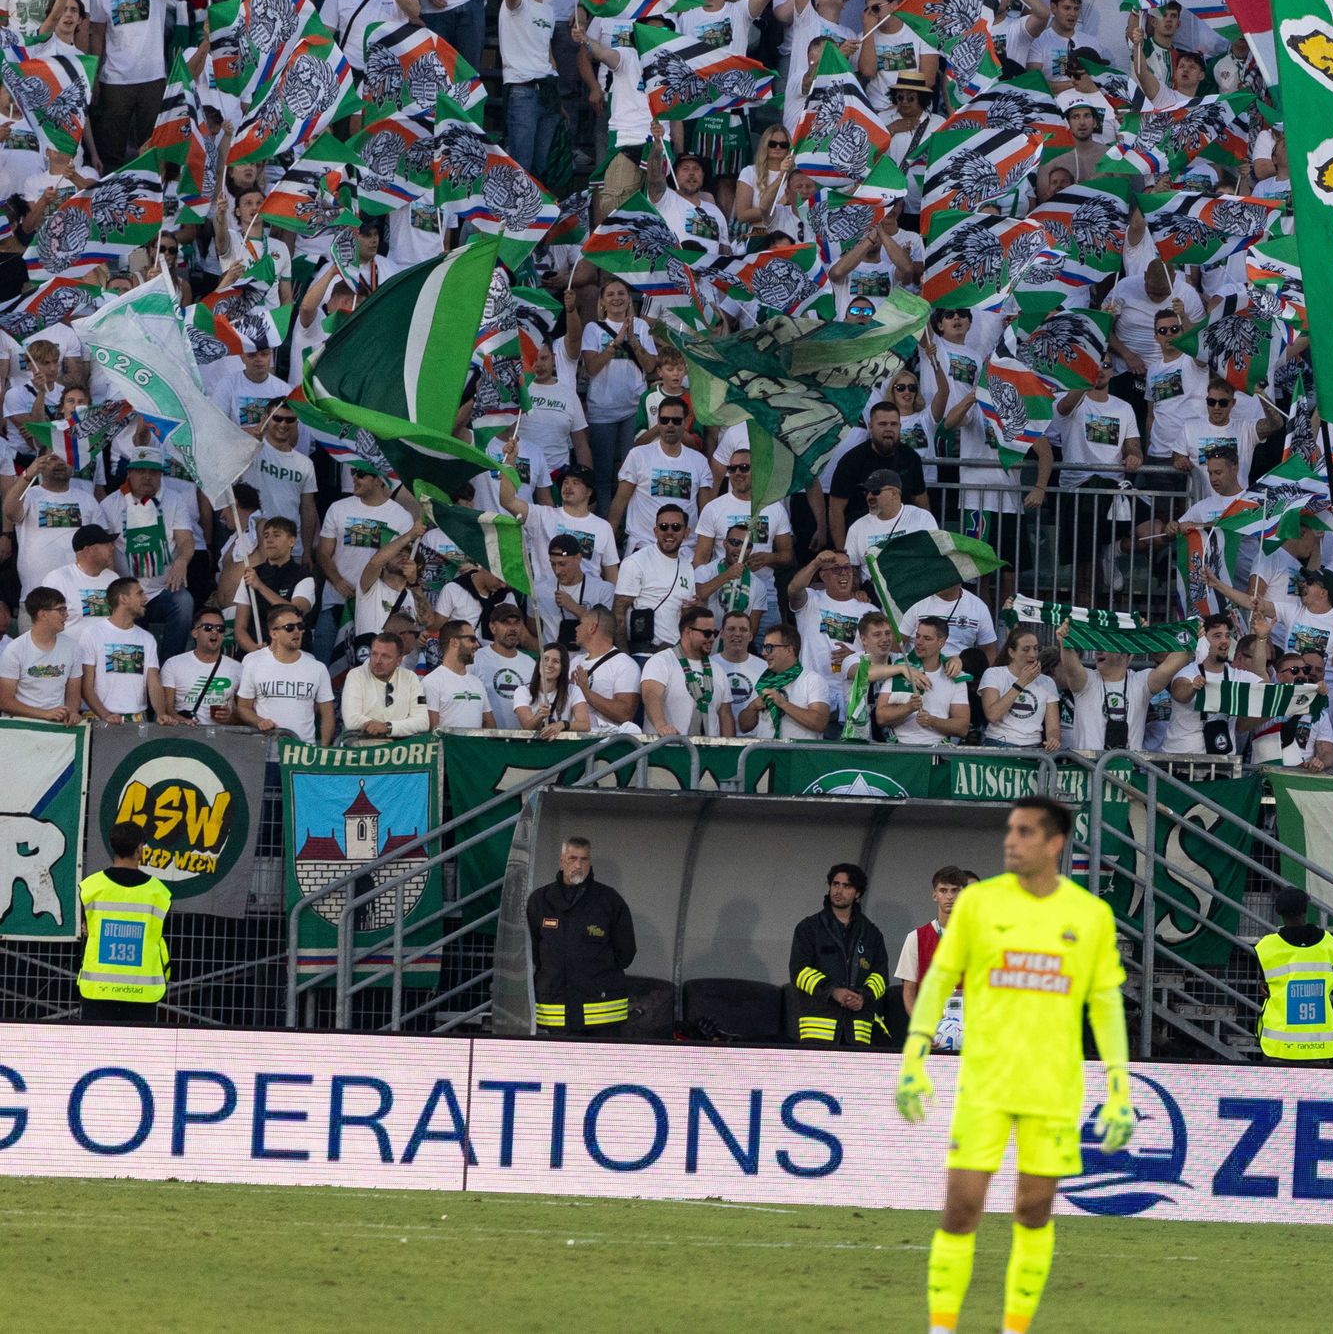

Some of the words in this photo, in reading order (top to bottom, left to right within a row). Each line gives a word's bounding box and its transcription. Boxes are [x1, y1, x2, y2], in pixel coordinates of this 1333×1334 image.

[260, 458, 303, 484] RAPID
[259, 680, 316, 699] WIENER
[282, 743, 440, 769] HÜTTELDORF
[173, 849, 218, 875] WIEN
[104, 923, 144, 939] STEWARD
[109, 943, 136, 962] 133
[1004, 951, 1062, 972] WIEN
[111, 984, 144, 995] randstad
[1290, 983, 1325, 997] STEWARD
[1299, 1002, 1318, 1020] 95
[1297, 1041, 1326, 1051] randstad
[68, 1068, 843, 1178] OPERATIONS
